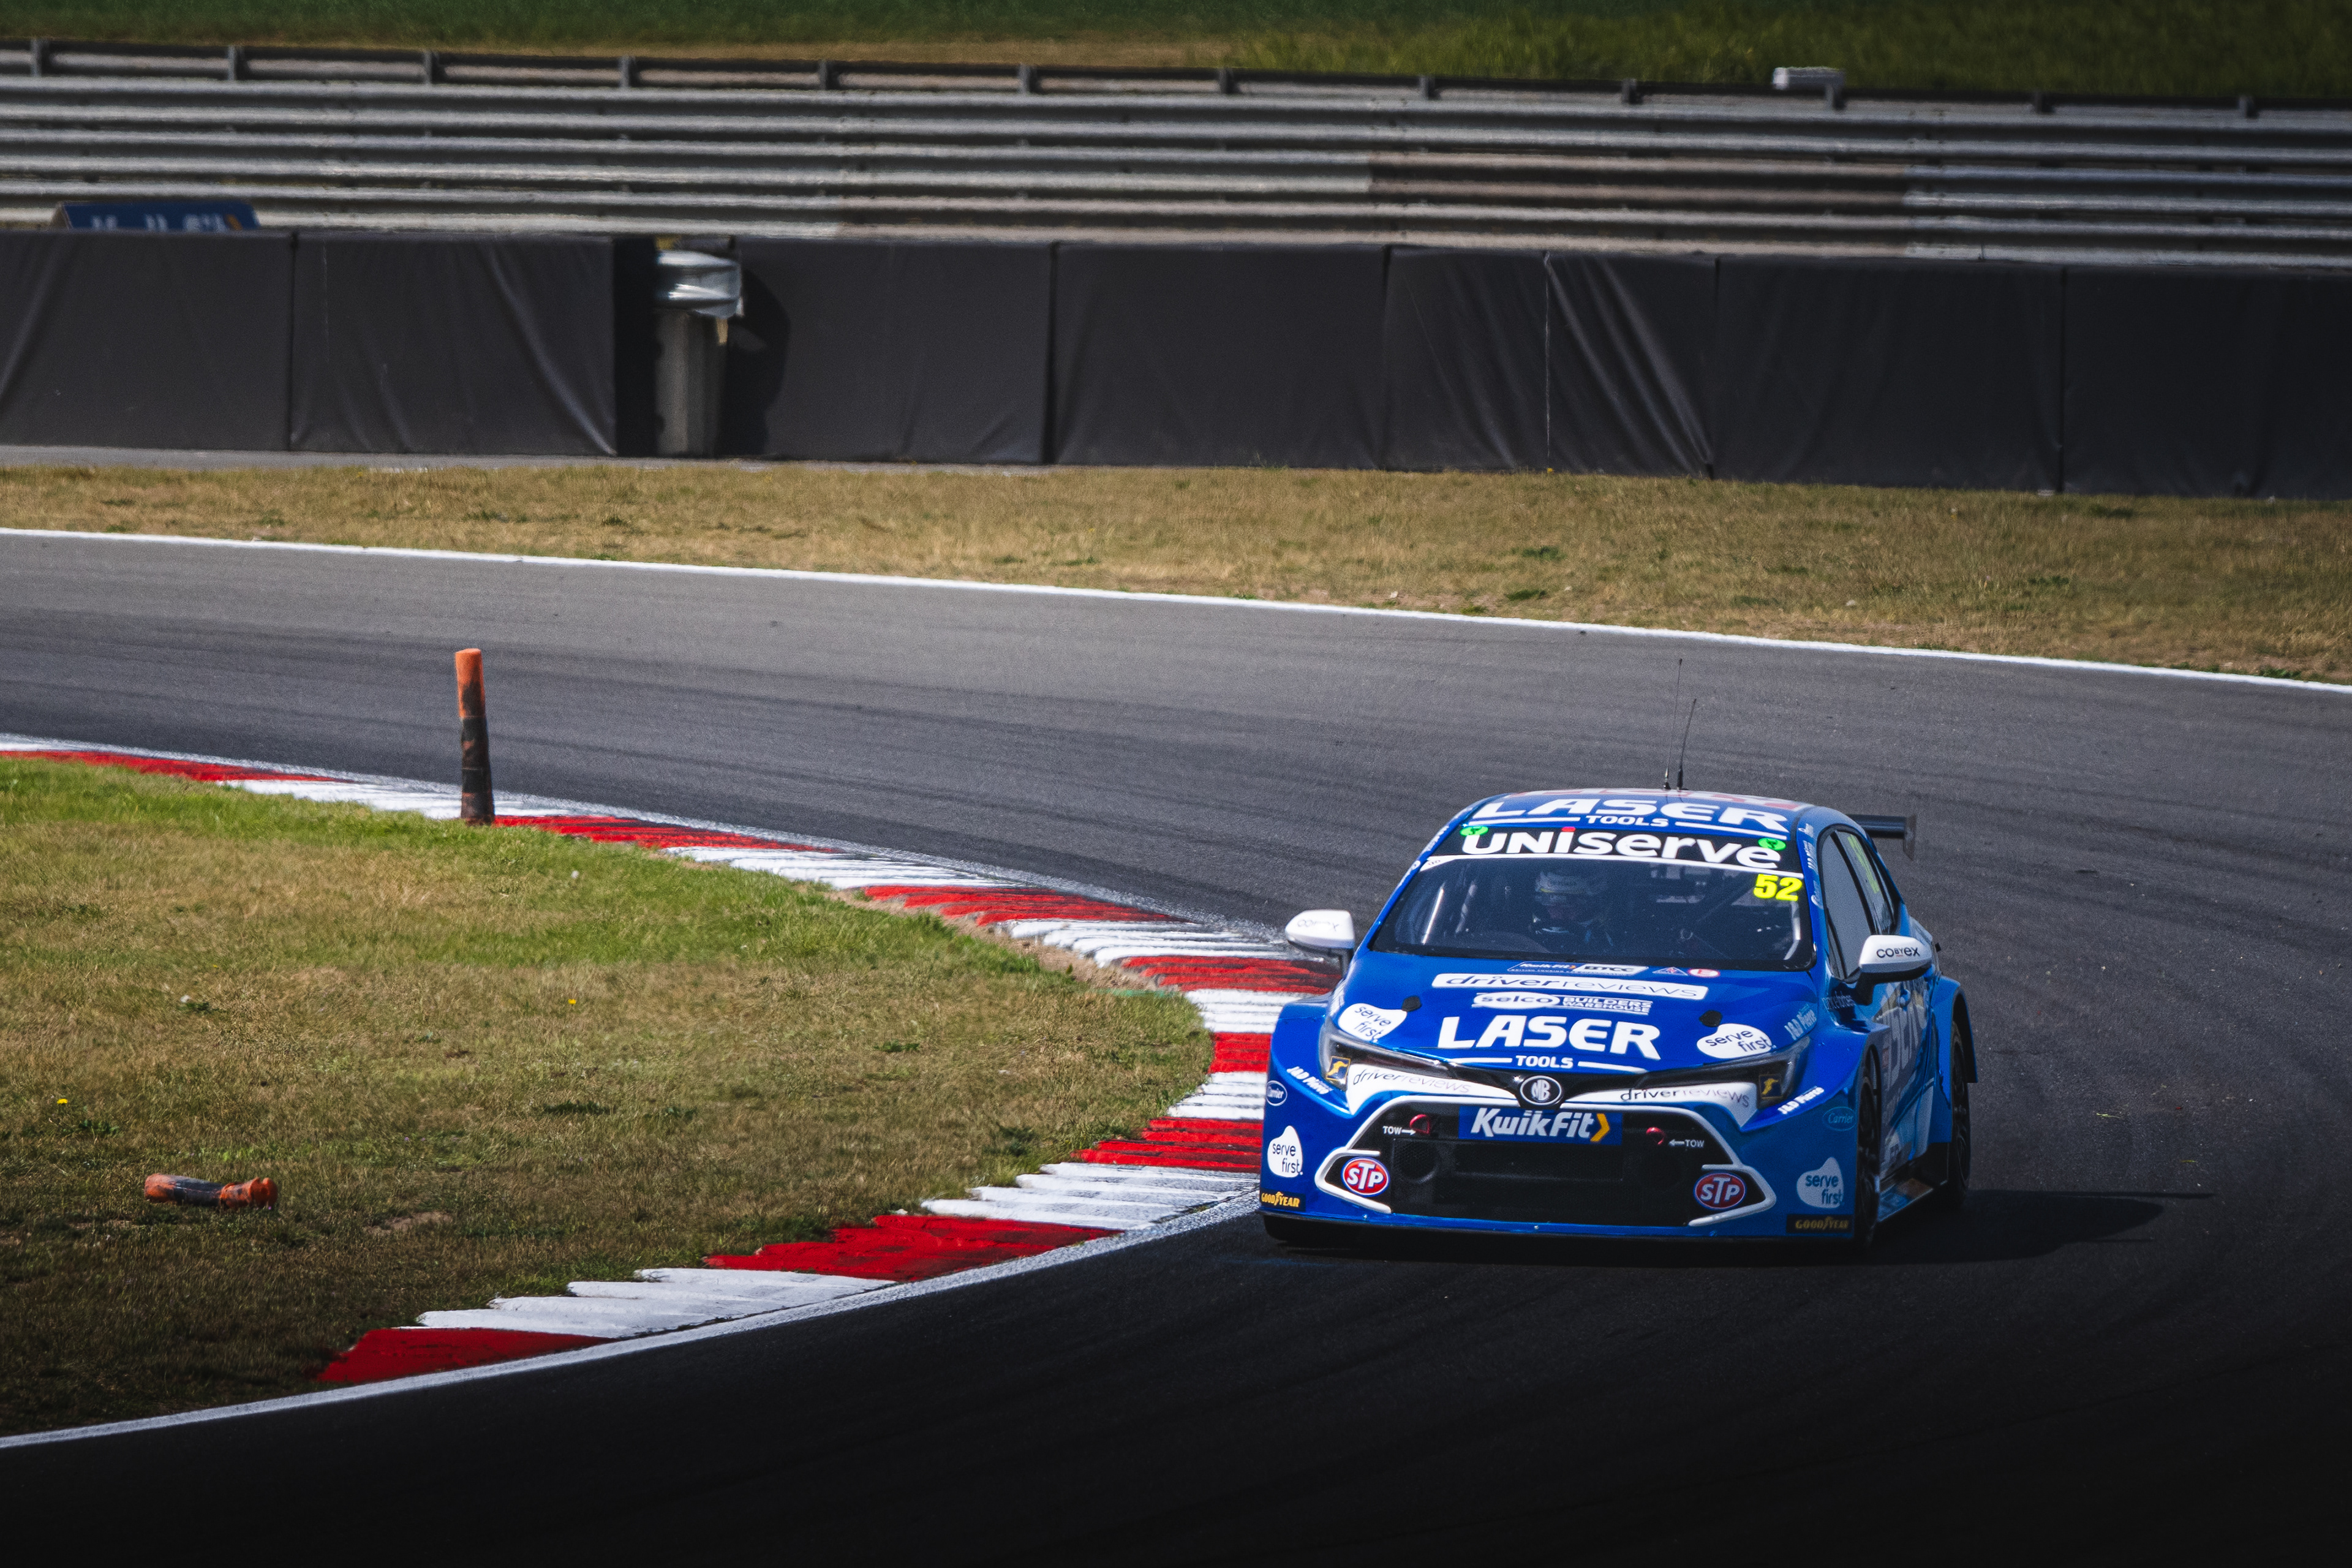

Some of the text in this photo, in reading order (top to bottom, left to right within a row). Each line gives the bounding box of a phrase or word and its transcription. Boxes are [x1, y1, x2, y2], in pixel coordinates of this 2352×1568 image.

[1472, 798, 1790, 832] LASER
[1585, 815, 1669, 827] TOOLS
[1753, 873, 1803, 902] 52
[1446, 975, 1697, 997] driverreviews
[1562, 997, 1652, 1008] BUILDERS
[1562, 1001, 1650, 1013] WAREHOUSE
[1354, 1006, 1392, 1027] serve
[1438, 1015, 1661, 1061] LASER
[1705, 1030, 1754, 1047] serve
[1515, 1055, 1574, 1069] TOOLS
[1382, 1126, 1403, 1135] TOW
[1272, 1142, 1297, 1157] serve
[1684, 1139, 1705, 1148] TOW
[1347, 1162, 1384, 1190] STP
[1805, 1174, 1839, 1187] serve
[1700, 1177, 1740, 1205] STP
[1261, 1191, 1300, 1208] GOODYEAR
[1795, 1216, 1850, 1231] GOODYEAR
